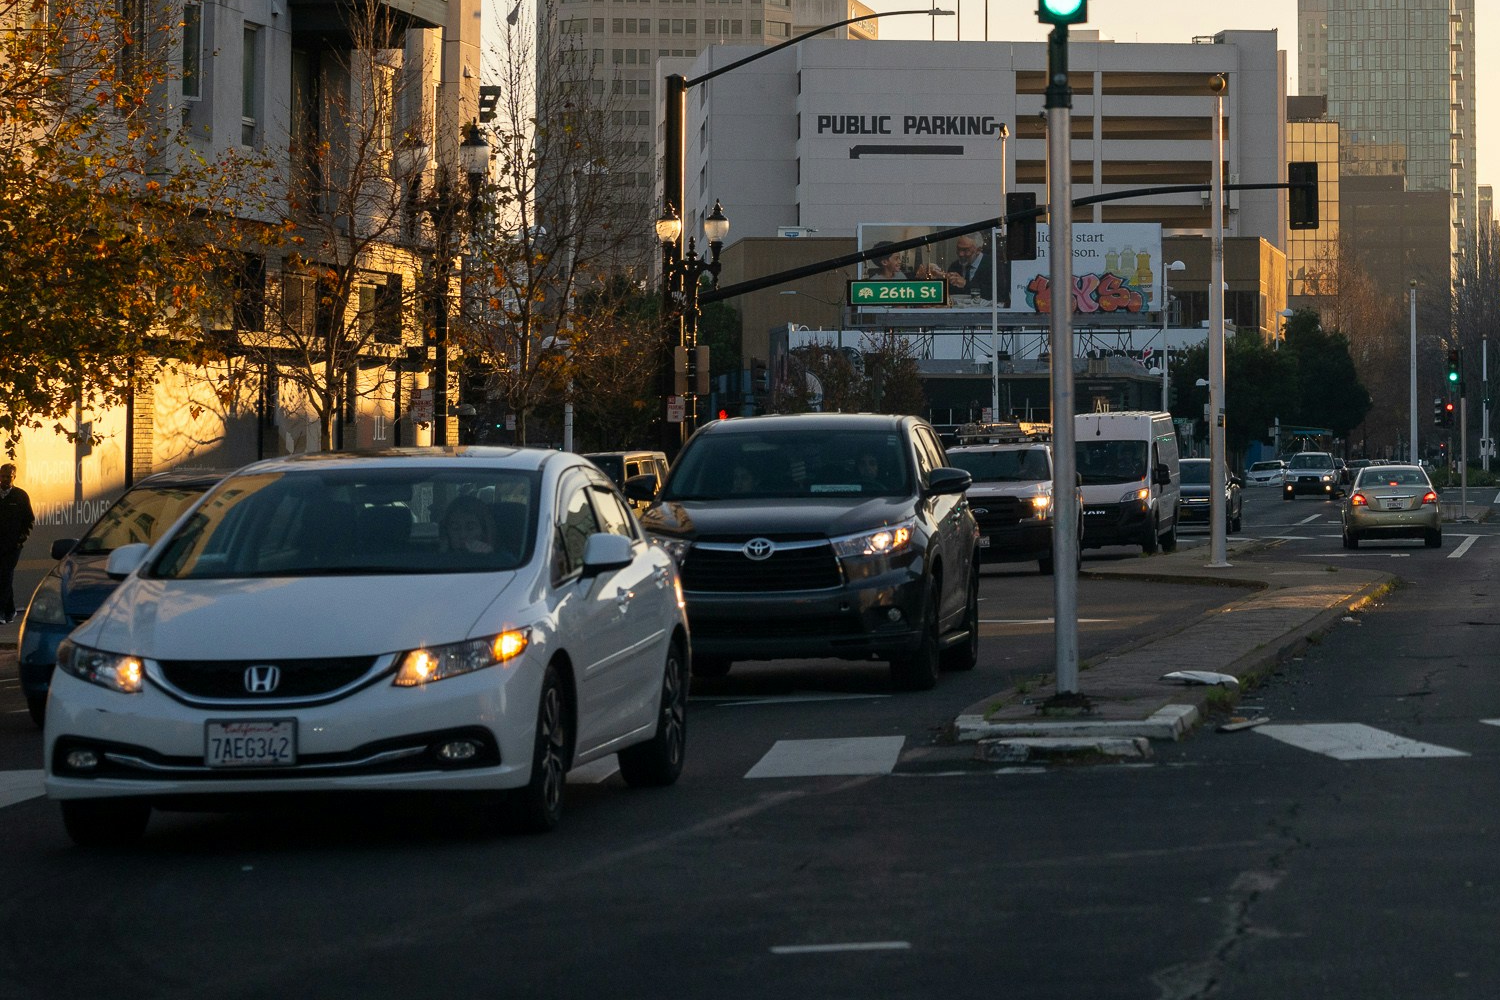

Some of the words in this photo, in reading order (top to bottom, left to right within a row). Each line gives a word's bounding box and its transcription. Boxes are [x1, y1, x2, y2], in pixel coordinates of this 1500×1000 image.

[818, 115, 891, 134] PUBLIC
[904, 116, 1000, 135] PARKING
[1076, 234, 1104, 242] start
[879, 287, 914, 298] 26th
[920, 286, 936, 298] St
[35, 502, 78, 526] RTMENT
[211, 737, 289, 759] 7AEG342
